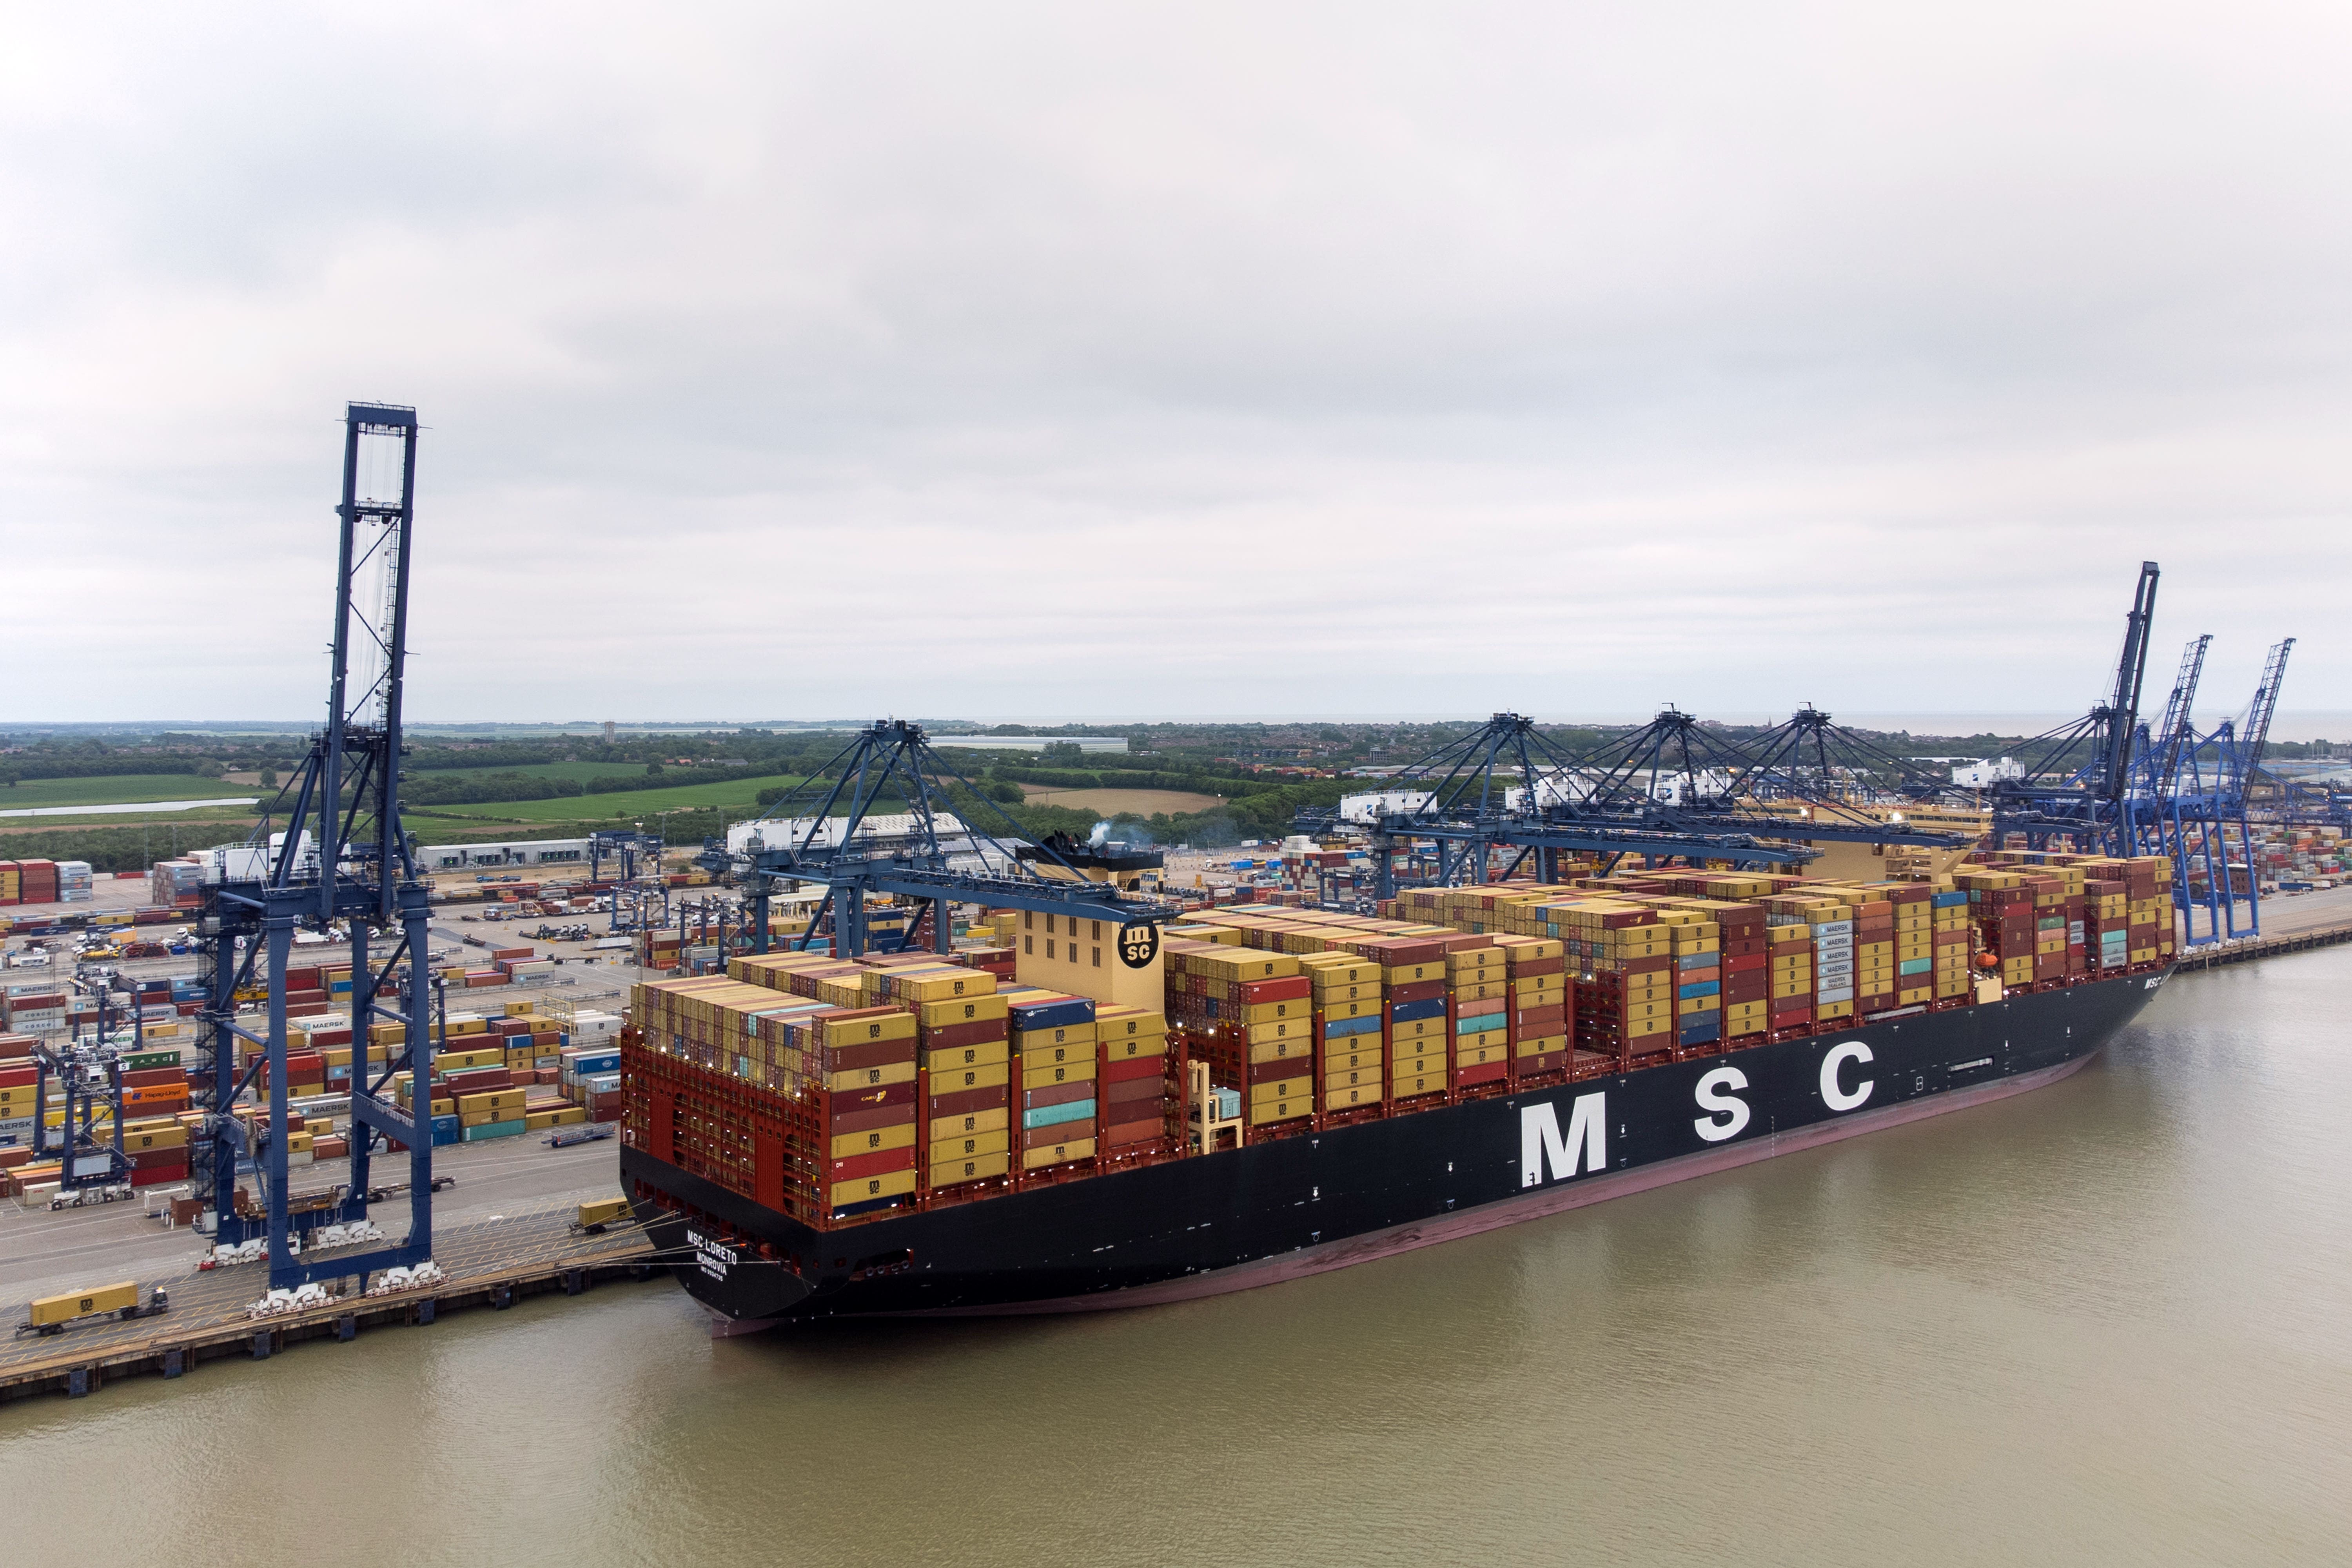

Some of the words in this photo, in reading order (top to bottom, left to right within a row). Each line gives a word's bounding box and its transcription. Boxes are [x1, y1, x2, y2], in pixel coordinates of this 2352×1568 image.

[2144, 976, 2161, 990] MSC
[312, 1103, 349, 1113] MAERSK
[688, 1229, 703, 1248] MSC
[706, 1239, 737, 1265] LORETO
[697, 1251, 727, 1276] MONROVIA
